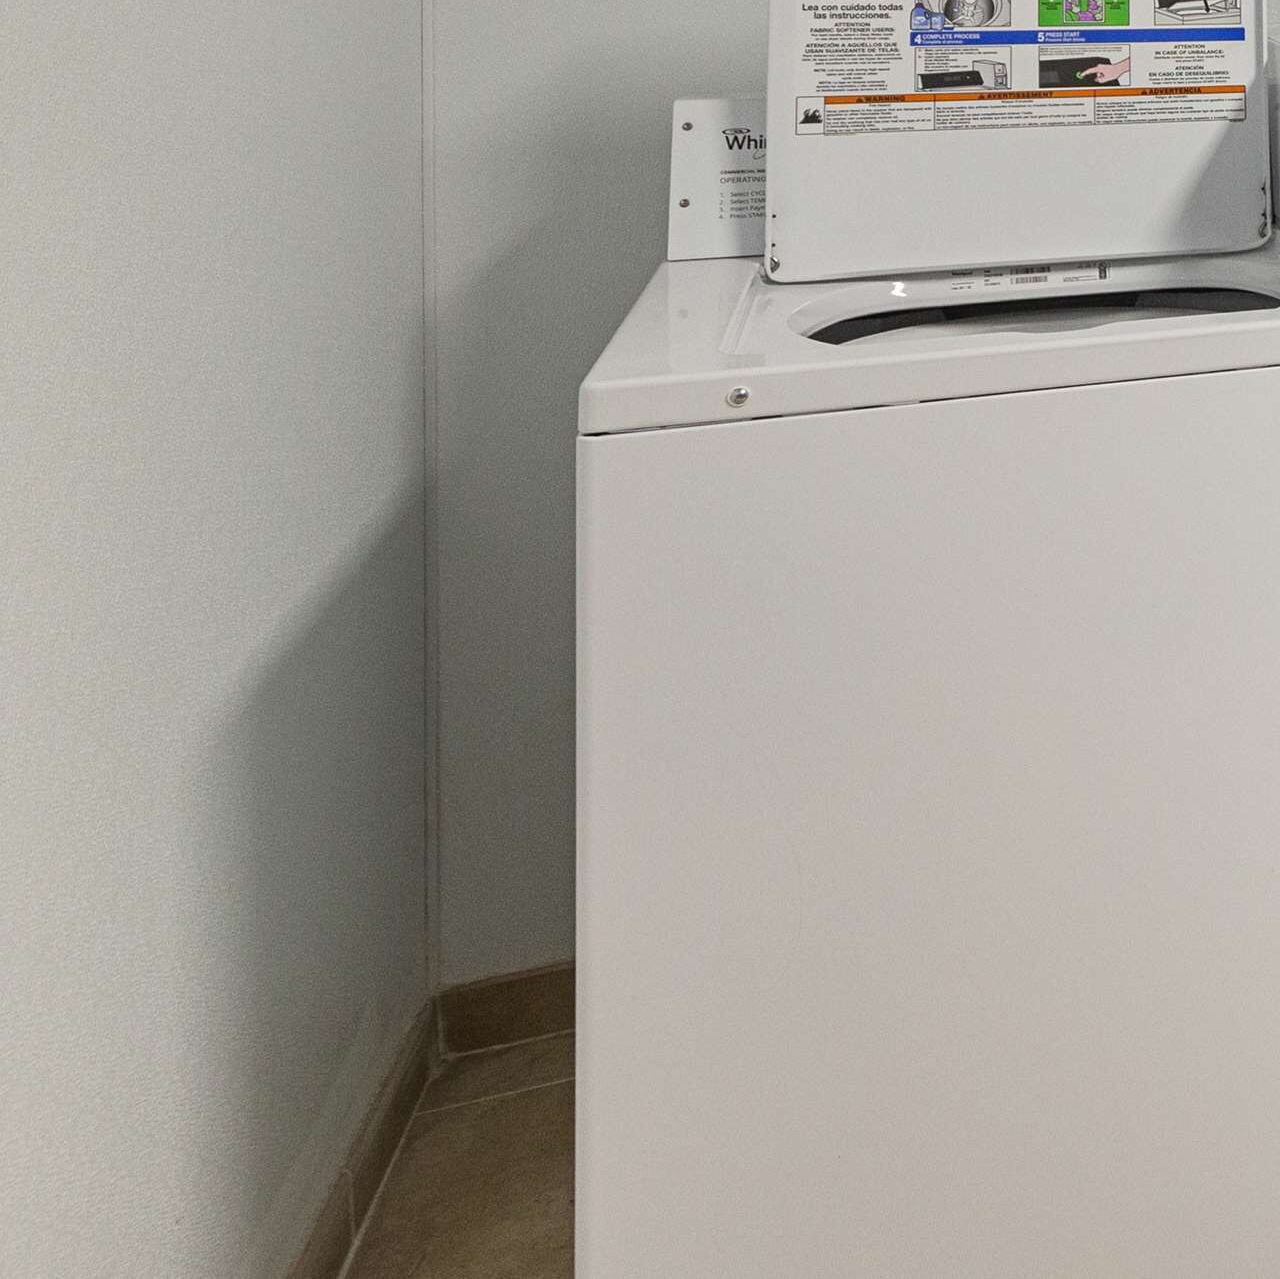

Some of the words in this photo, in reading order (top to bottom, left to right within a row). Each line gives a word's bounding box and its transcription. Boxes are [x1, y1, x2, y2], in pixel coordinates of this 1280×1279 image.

[840, 3, 876, 11] cuidado
[878, 3, 904, 11] todas
[914, 34, 922, 44] 4
[1037, 32, 1045, 42] 5
